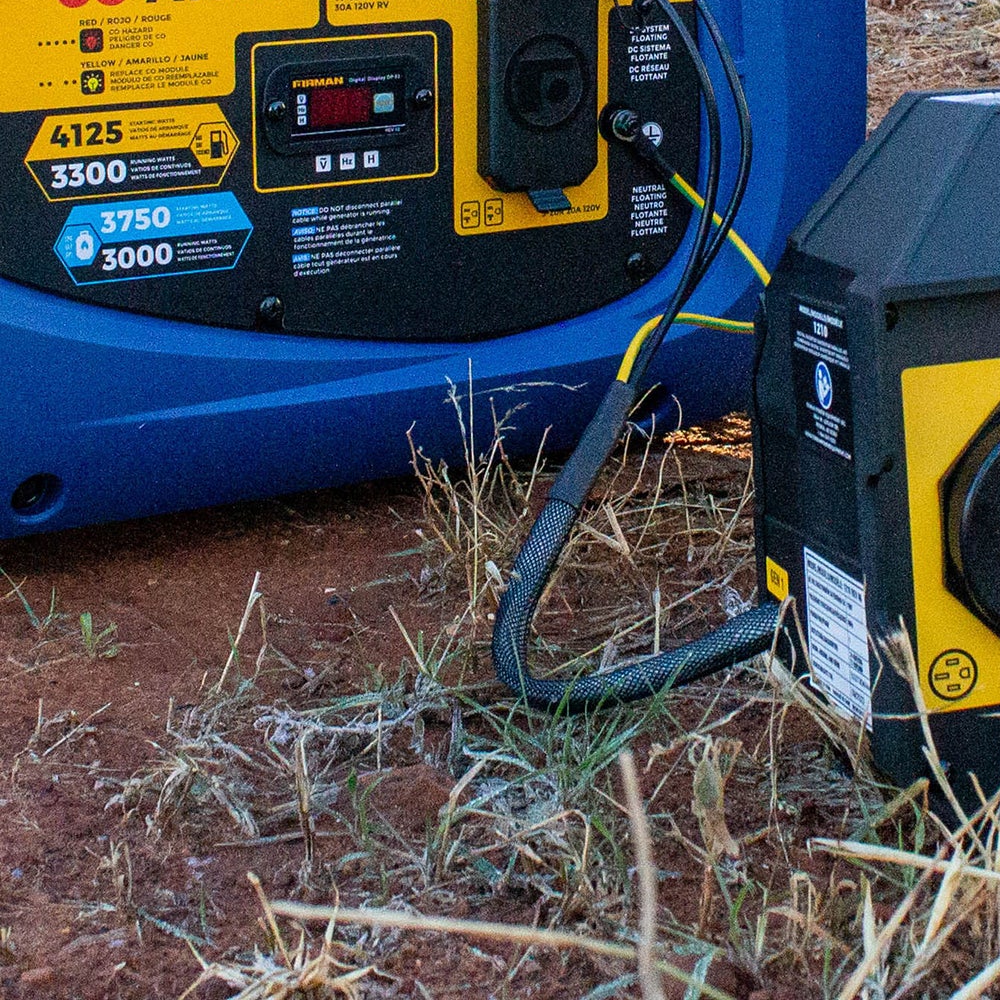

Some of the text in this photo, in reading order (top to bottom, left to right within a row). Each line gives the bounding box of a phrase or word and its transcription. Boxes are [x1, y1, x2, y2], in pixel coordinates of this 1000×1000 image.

[334, 0, 389, 12] 30A 120V RV
[107, 17, 131, 25] ROJO
[141, 14, 172, 22] ROUGE
[631, 33, 667, 43] FLOATING
[628, 43, 672, 54] DC SISTEMA
[80, 53, 209, 68] YELLOW AMARILLO JAUNE
[630, 52, 668, 62] FLOTANTE
[629, 63, 670, 74] DC RÉSEAU
[292, 76, 344, 89] FIRMAN
[630, 72, 667, 82] FLOTTANT
[50, 120, 123, 148] 4125
[342, 157, 353, 166] Hz
[367, 154, 375, 164] H
[50, 159, 127, 189] 3300
[632, 184, 666, 194] NEUTRAL
[631, 192, 667, 202] FLOATING
[633, 201, 664, 210] NEUTRO
[100, 206, 171, 234] 3750
[630, 209, 668, 220] FLOTANTE
[634, 218, 664, 227] NEUTRE
[630, 226, 668, 237] FLOTTANT
[102, 242, 173, 271] 3000
[812, 321, 828, 338] 1210
[770, 568, 781, 588] GEN
